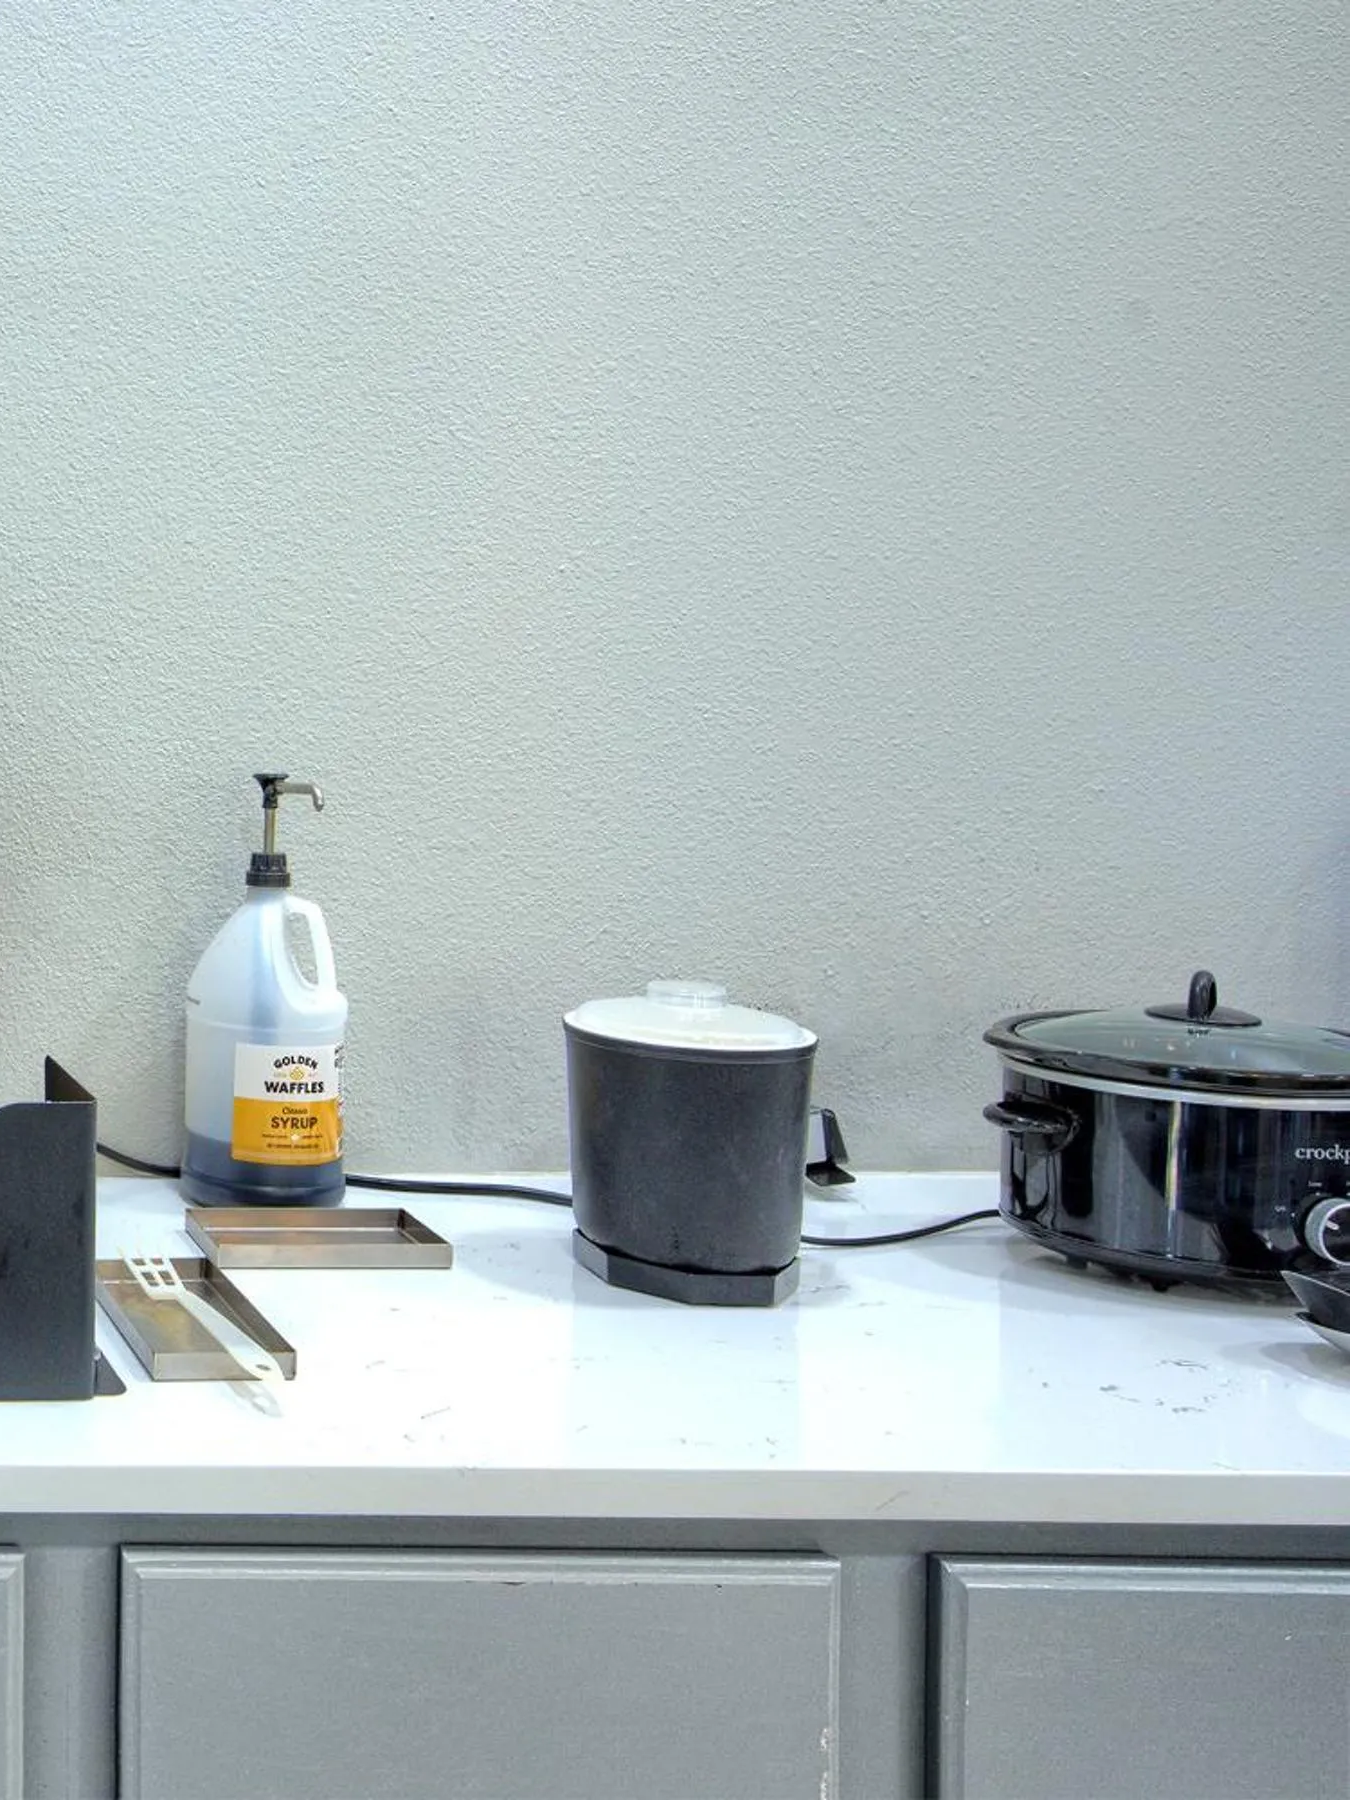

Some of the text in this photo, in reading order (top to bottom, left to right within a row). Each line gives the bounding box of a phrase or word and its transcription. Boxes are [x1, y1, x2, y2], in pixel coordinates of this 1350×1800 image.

[273, 1055, 319, 1069] GOLDEN
[264, 1081, 325, 1094] WAFFLES
[271, 1116, 318, 1129] SYRUP
